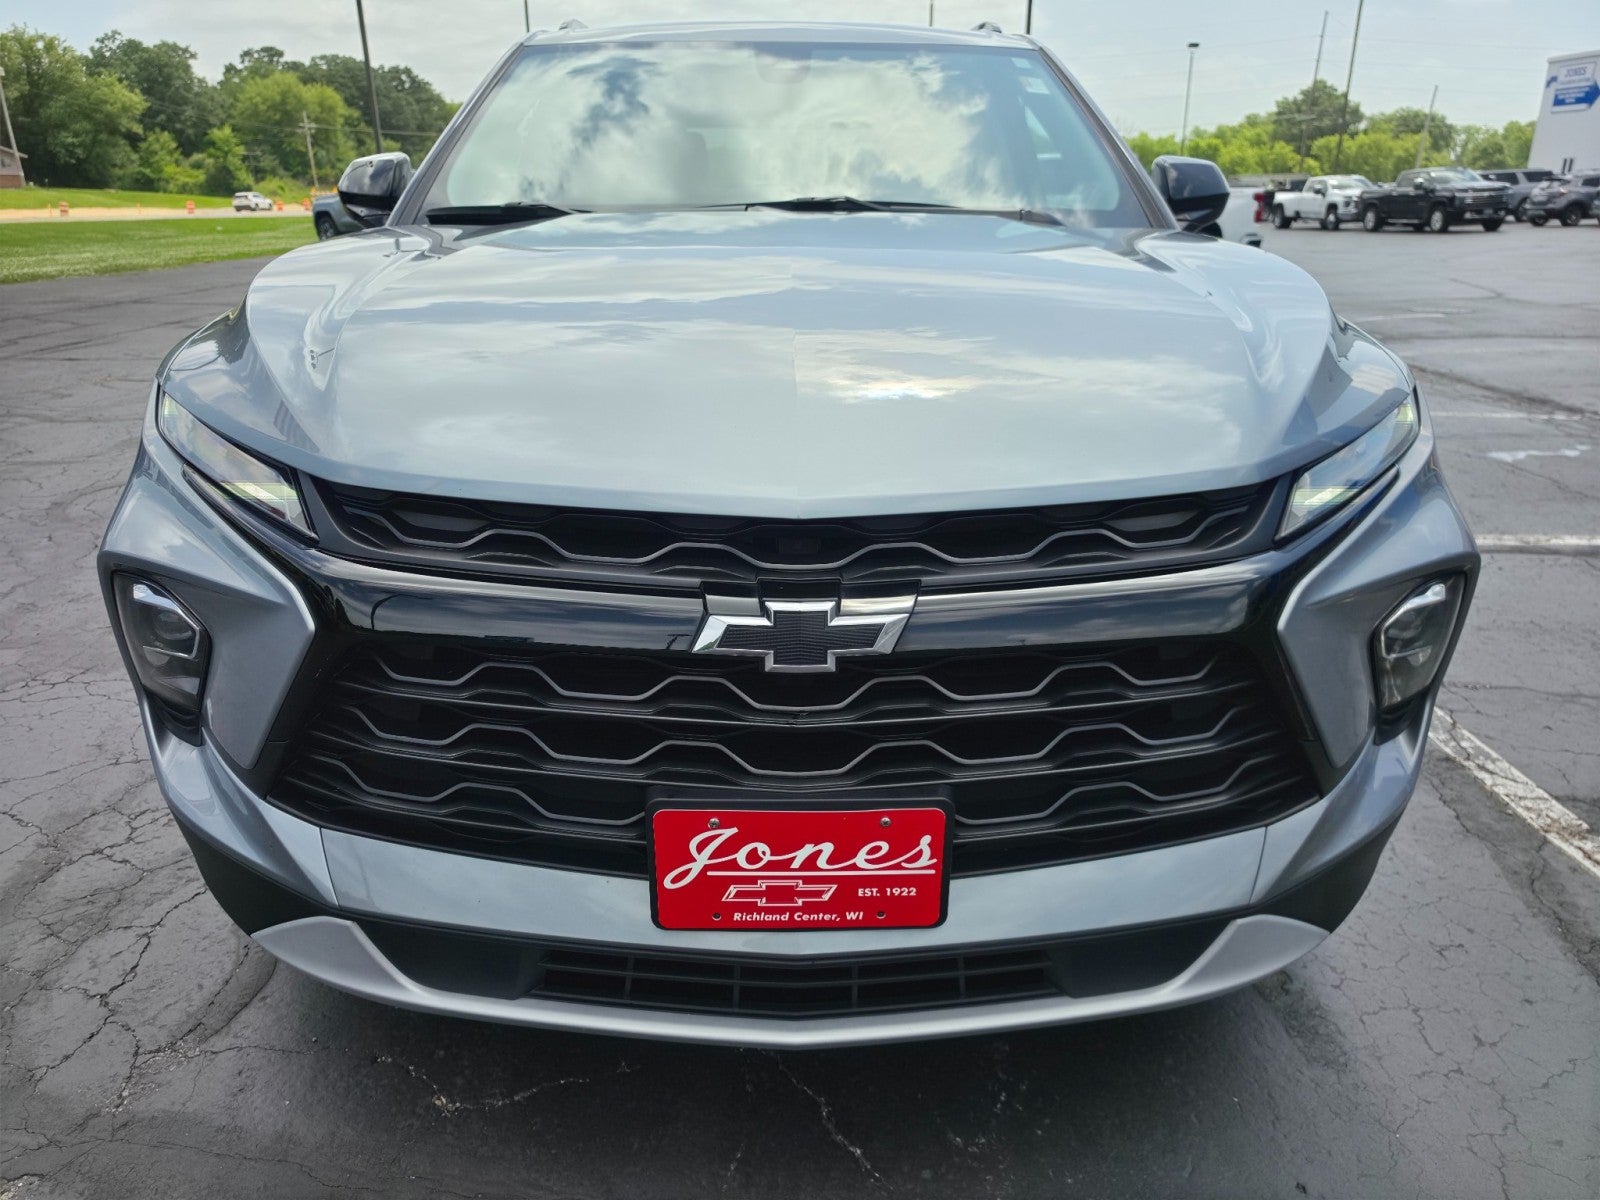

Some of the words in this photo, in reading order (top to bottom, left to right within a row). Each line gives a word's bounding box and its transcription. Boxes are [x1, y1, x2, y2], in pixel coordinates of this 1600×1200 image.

[663, 827, 937, 889] Jones
[857, 887, 880, 897] EST.
[886, 887, 917, 897] 1922
[733, 911, 789, 922] Richland
[793, 911, 841, 923] Center,
[845, 911, 864, 921] WI
